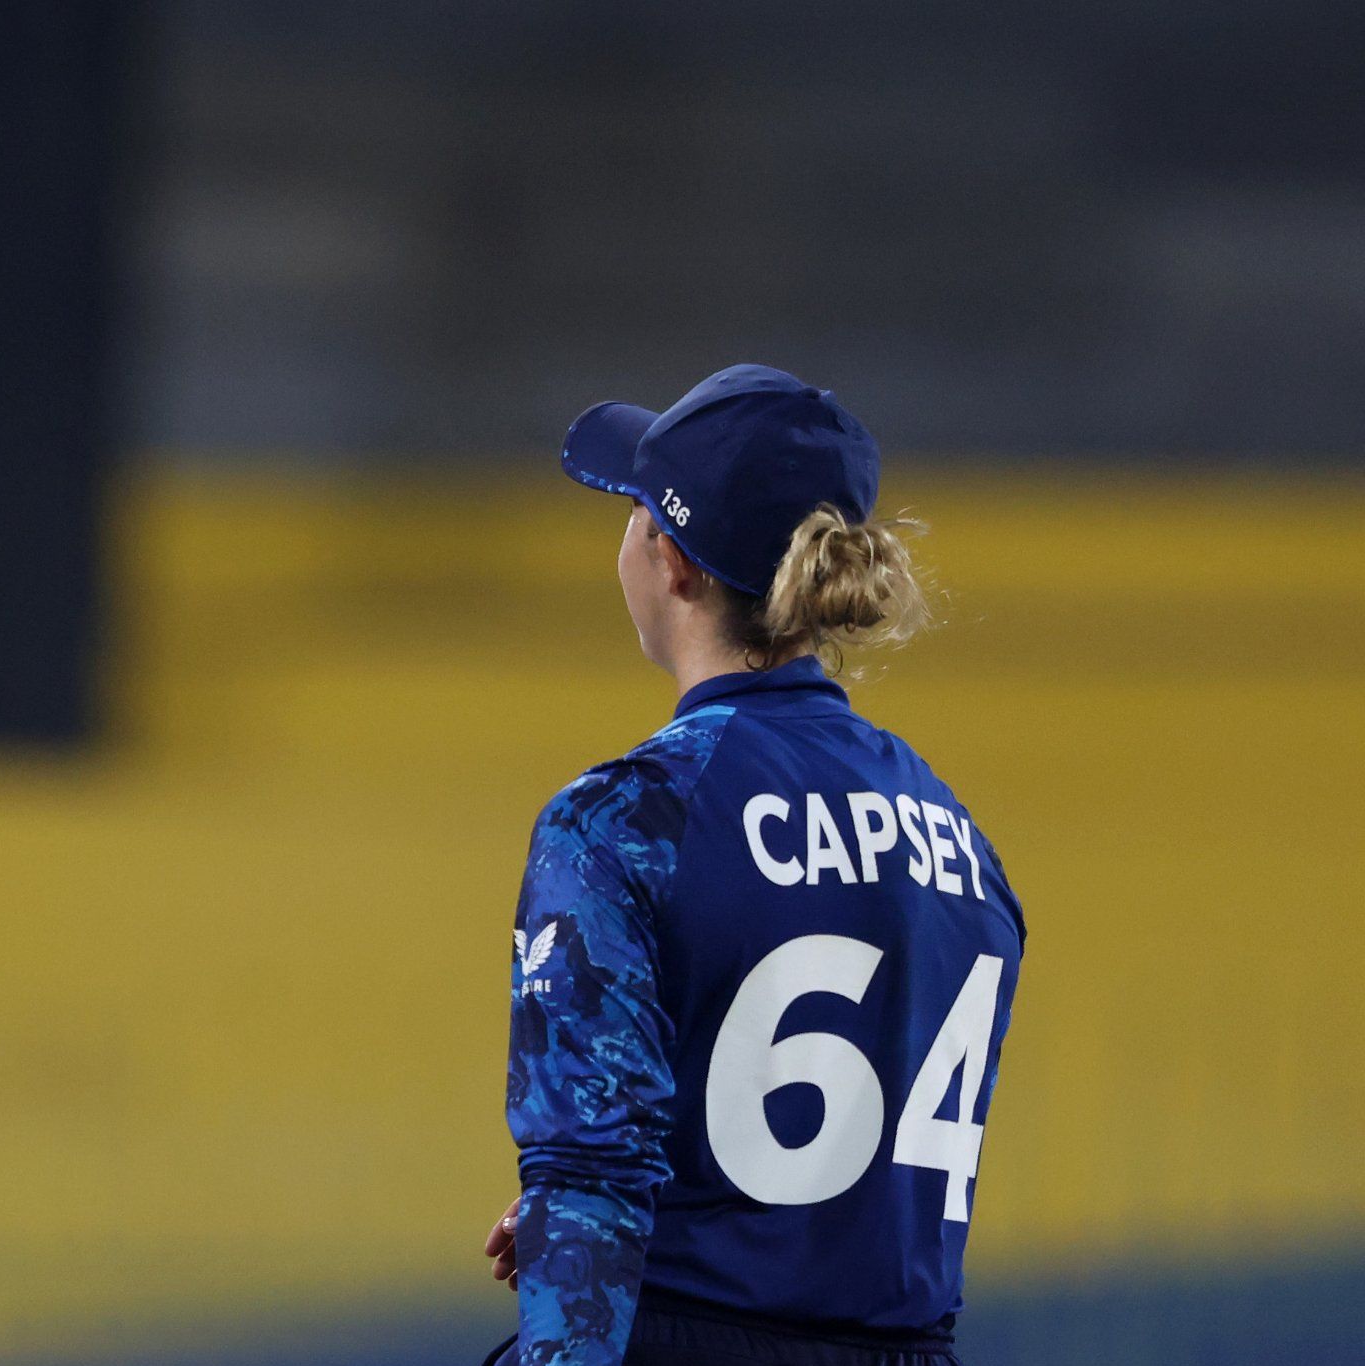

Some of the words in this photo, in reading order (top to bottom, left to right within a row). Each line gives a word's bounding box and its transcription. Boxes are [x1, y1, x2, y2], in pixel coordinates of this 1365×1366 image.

[661, 488, 691, 527] 136
[742, 791, 986, 901] CAPSEY
[705, 934, 1004, 1223] 64
